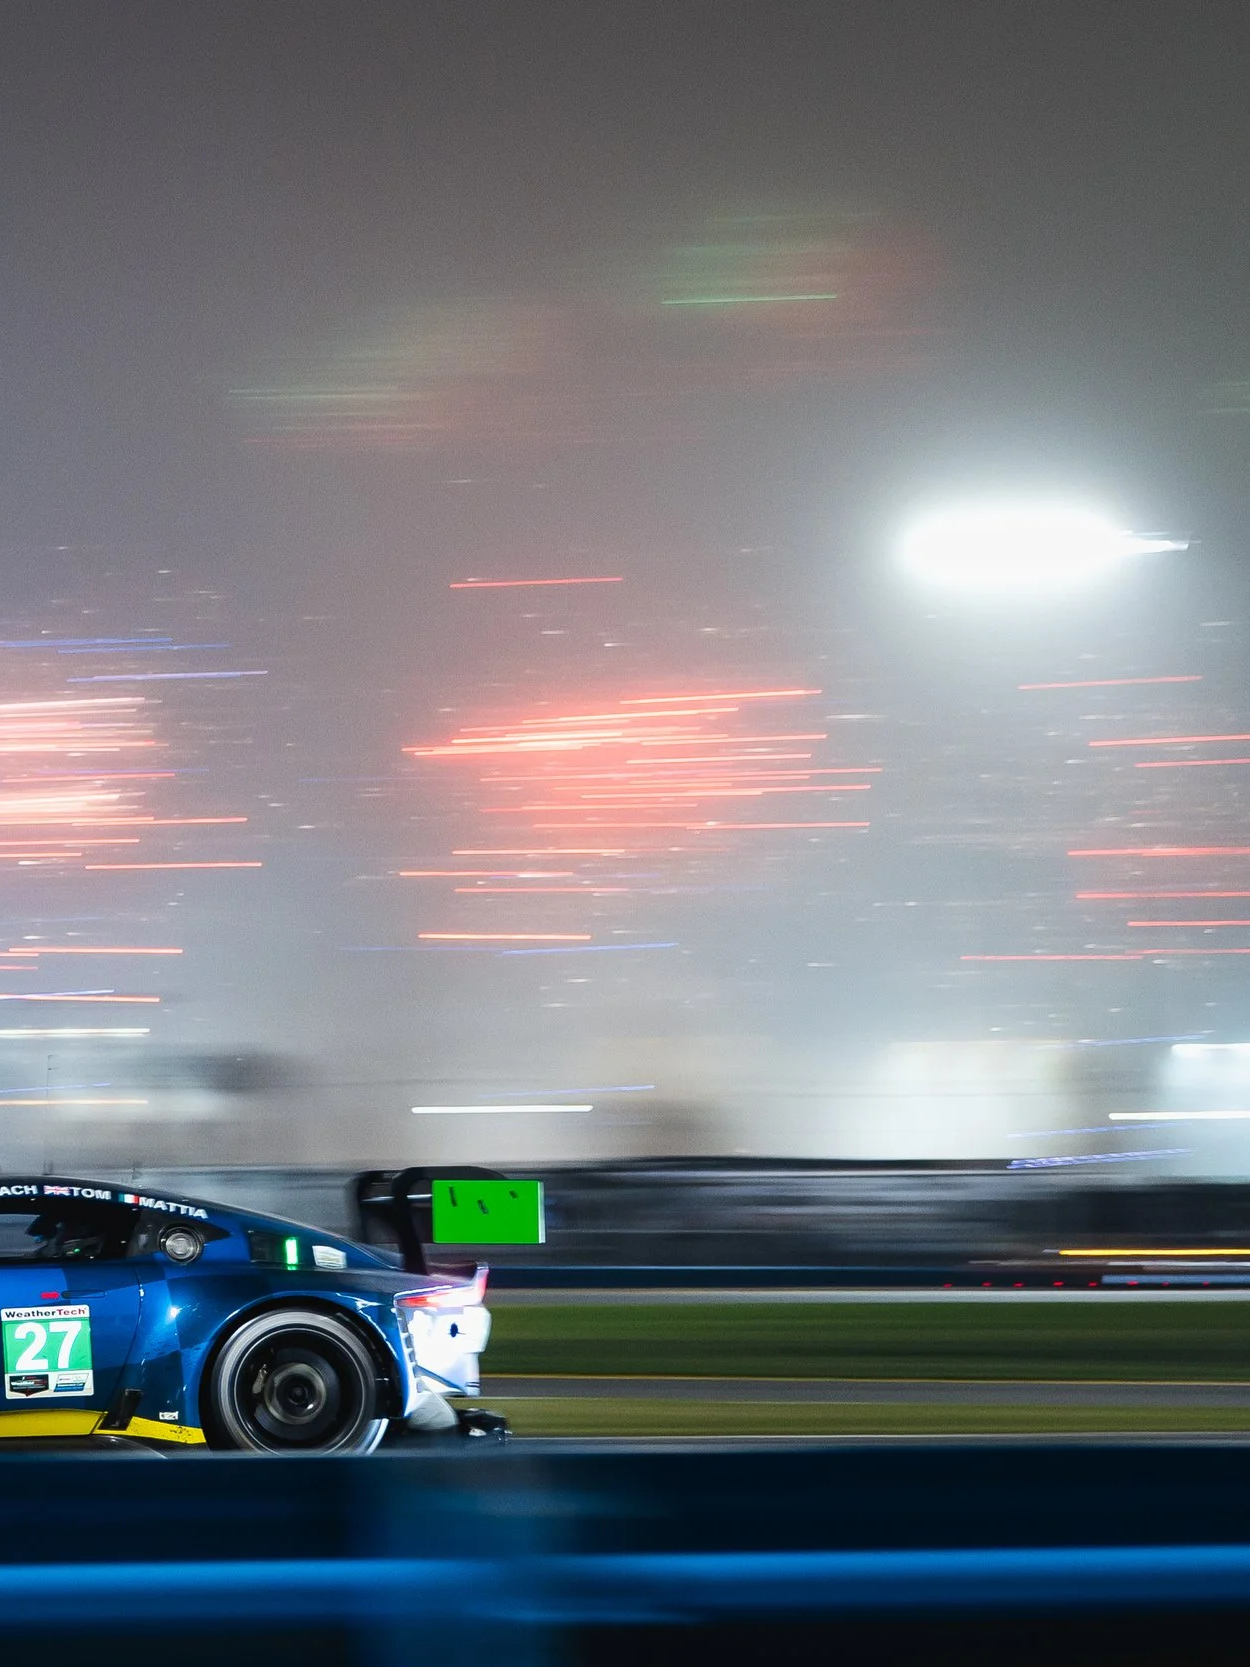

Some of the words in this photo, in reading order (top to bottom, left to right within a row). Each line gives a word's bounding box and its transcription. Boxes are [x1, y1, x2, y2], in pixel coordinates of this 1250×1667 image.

[70, 1186, 112, 1200] TOM
[138, 1196, 209, 1219] MATTIA
[5, 1308, 86, 1318] WeatherTech
[14, 1321, 82, 1371] 27
